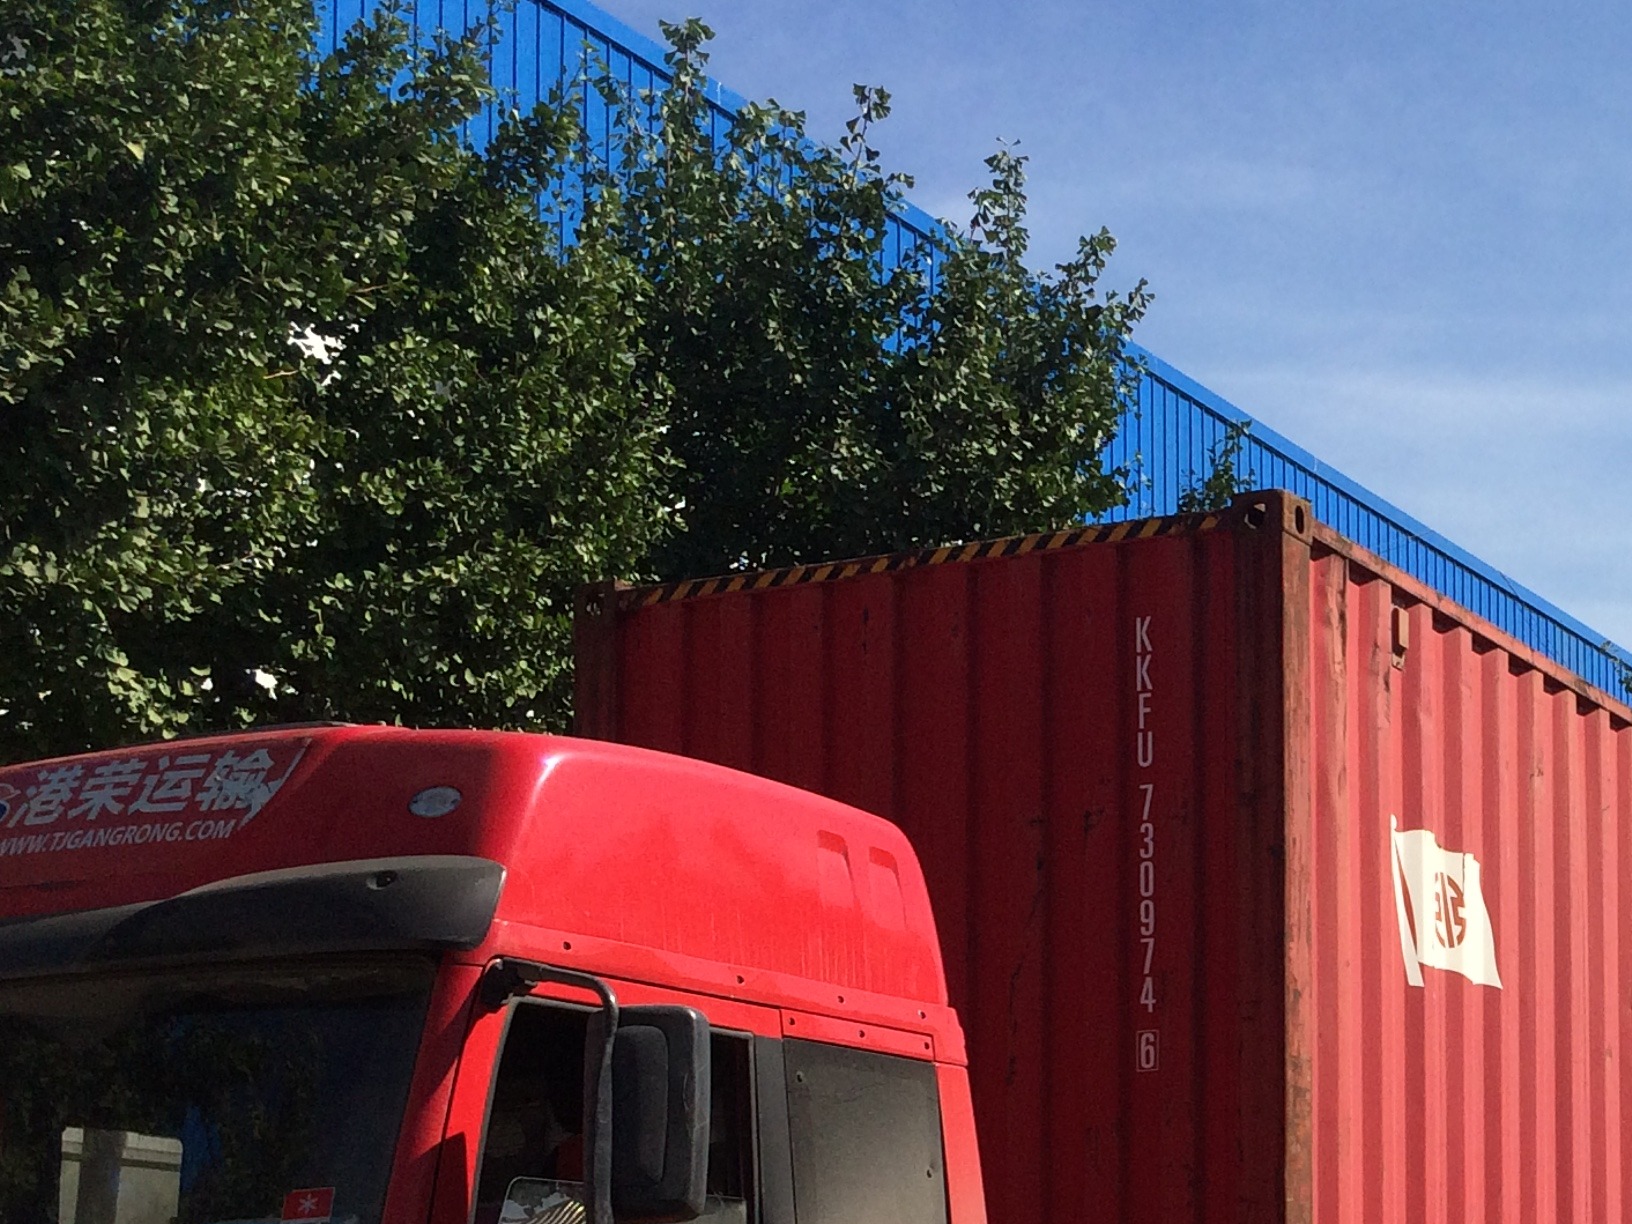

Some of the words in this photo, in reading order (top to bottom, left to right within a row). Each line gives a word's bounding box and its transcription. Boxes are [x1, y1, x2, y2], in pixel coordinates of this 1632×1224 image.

[1135, 616, 1154, 767] KKFU
[8, 749, 276, 829] 港荣运输
[1138, 784, 1156, 1013] 730974
[1139, 1032, 1156, 1069] 6
